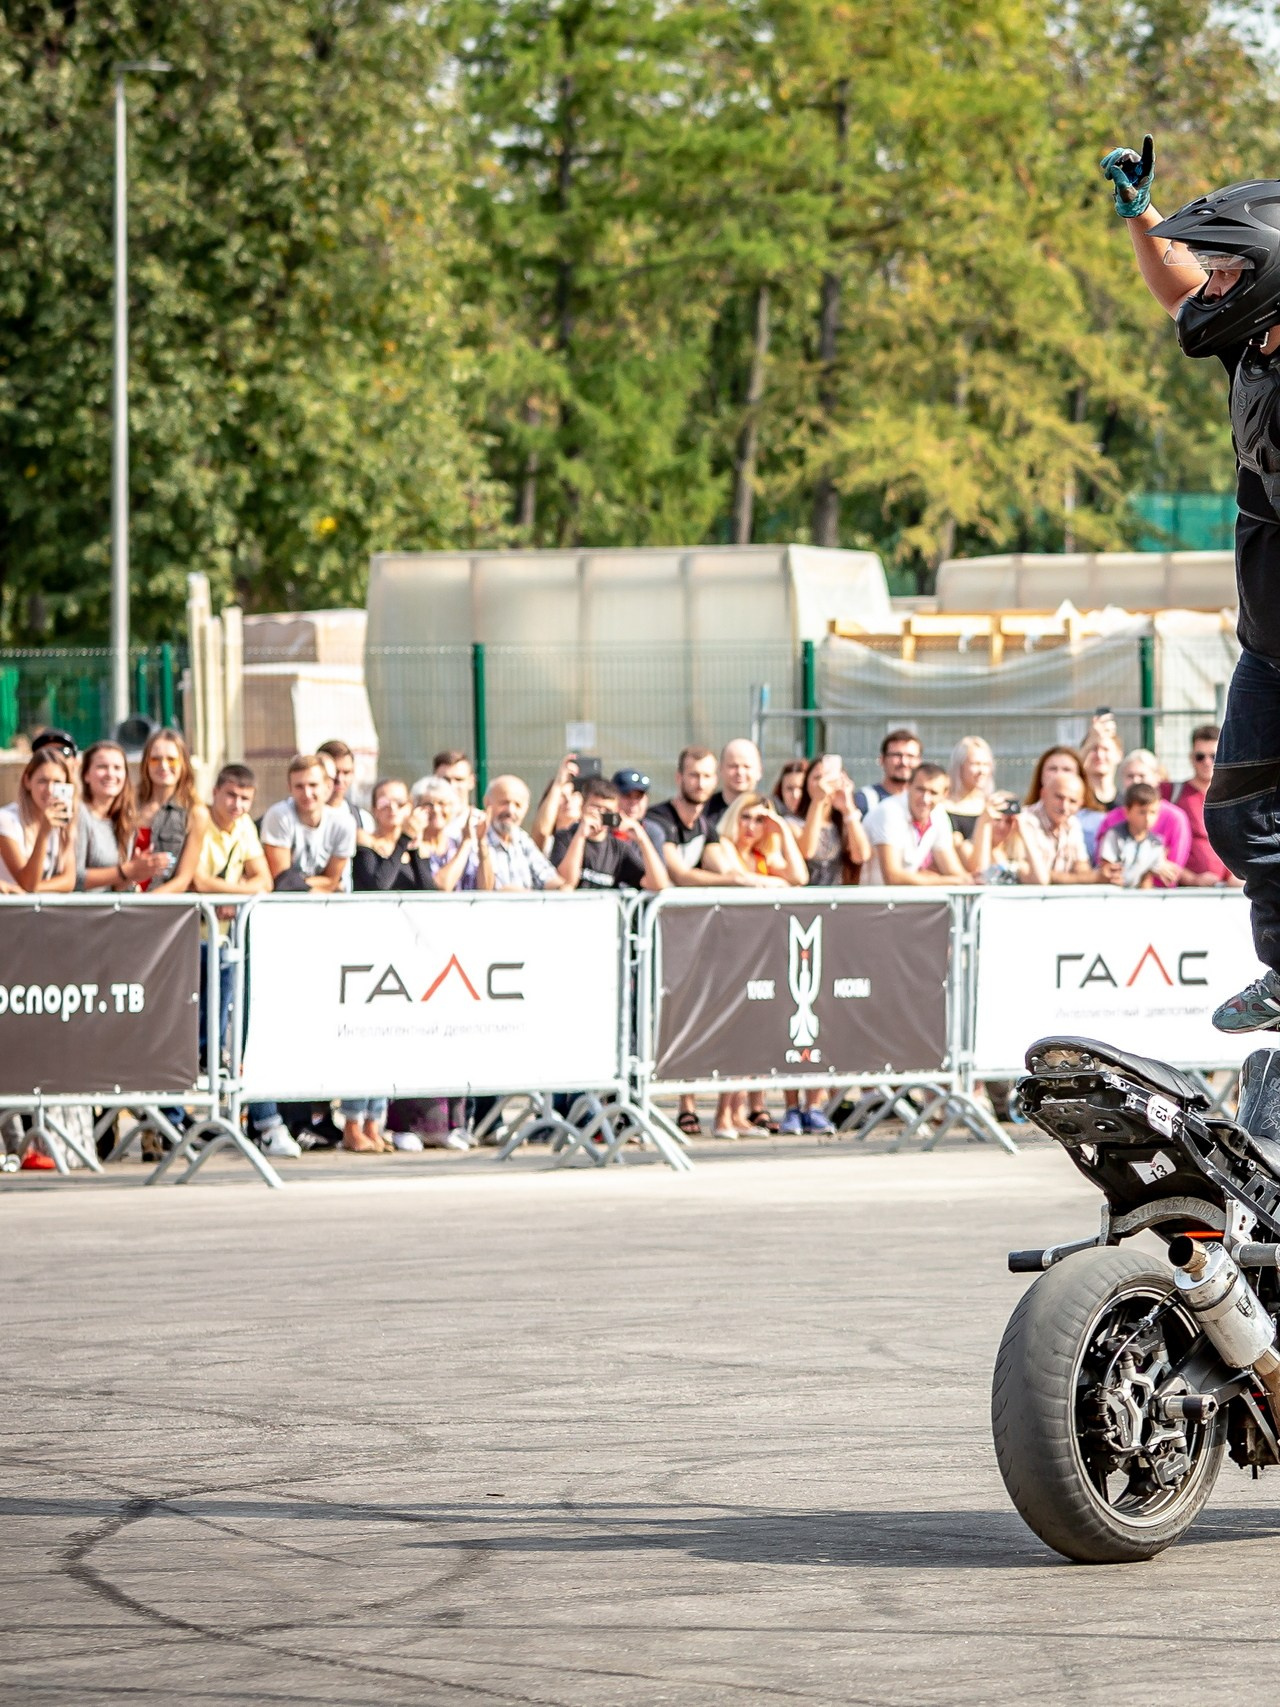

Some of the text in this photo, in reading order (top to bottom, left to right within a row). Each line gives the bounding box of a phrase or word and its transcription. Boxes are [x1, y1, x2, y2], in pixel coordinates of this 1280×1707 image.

[339, 952, 525, 1004] ГАЛС
[1056, 943, 1209, 989] ГАЛС
[1155, 1105, 1168, 1122] 13
[1150, 1164, 1168, 1181] 13
